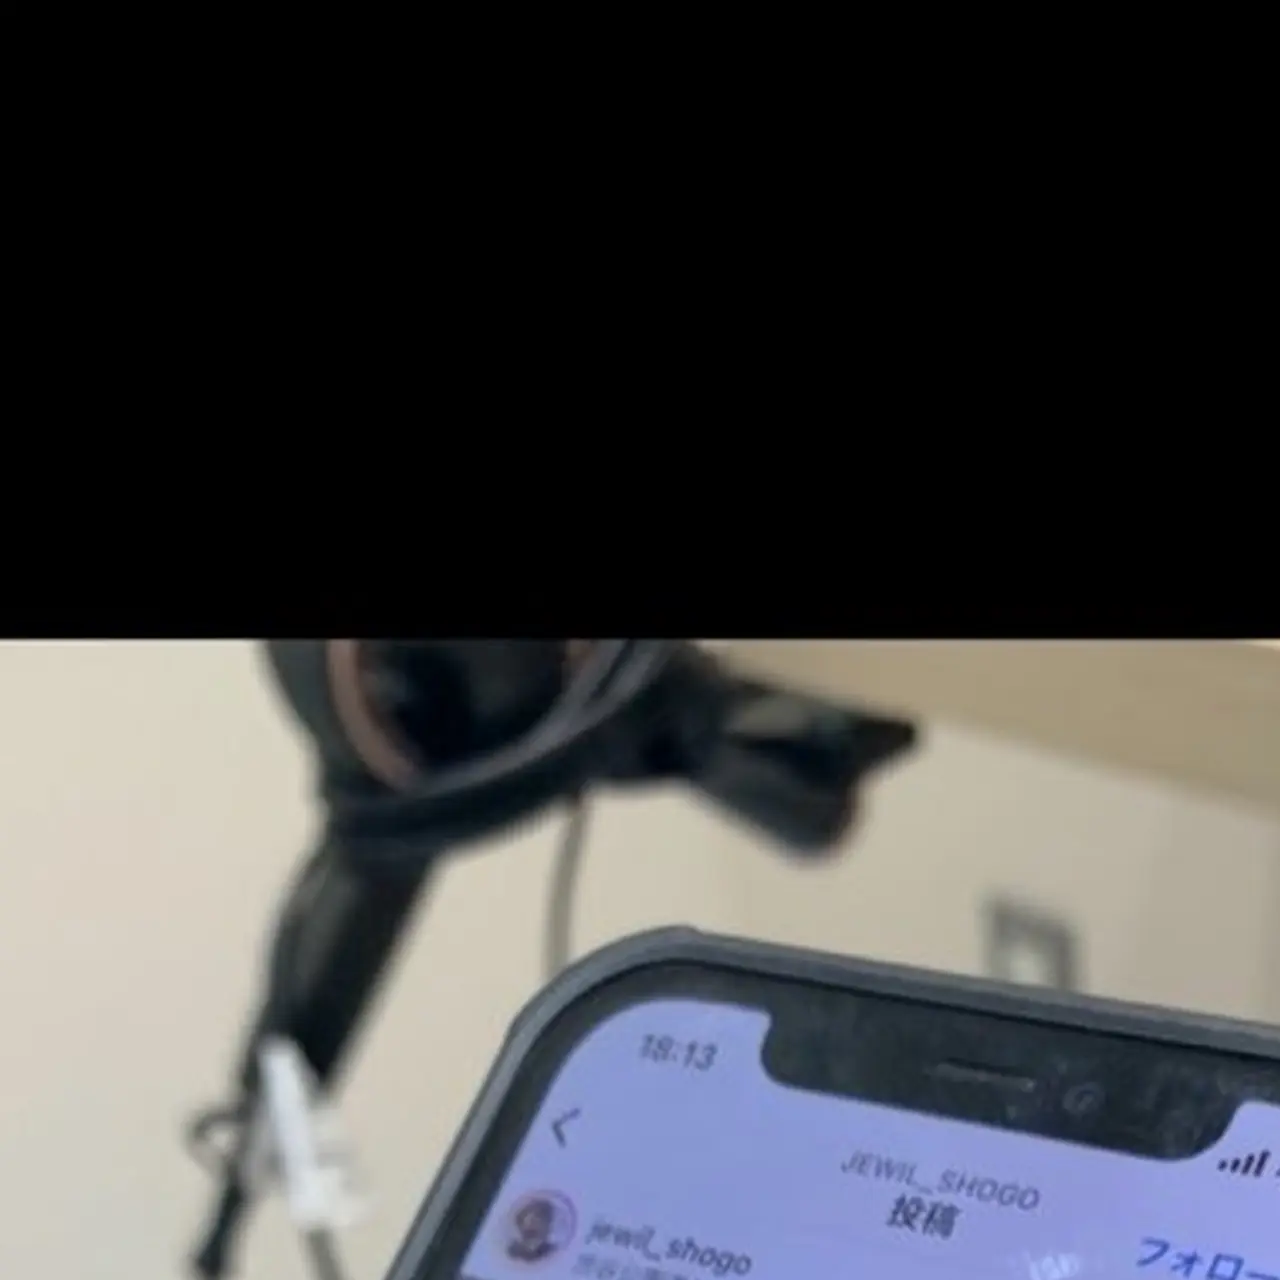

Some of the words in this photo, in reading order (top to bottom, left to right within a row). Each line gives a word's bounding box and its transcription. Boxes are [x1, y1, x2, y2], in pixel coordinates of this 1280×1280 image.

[639, 1033, 718, 1072] 18:13
[840, 1149, 1040, 1211] JEWIL_SHOGO
[886, 1193, 963, 1240] 投稿
[584, 1222, 752, 1277] jewil_shogo
